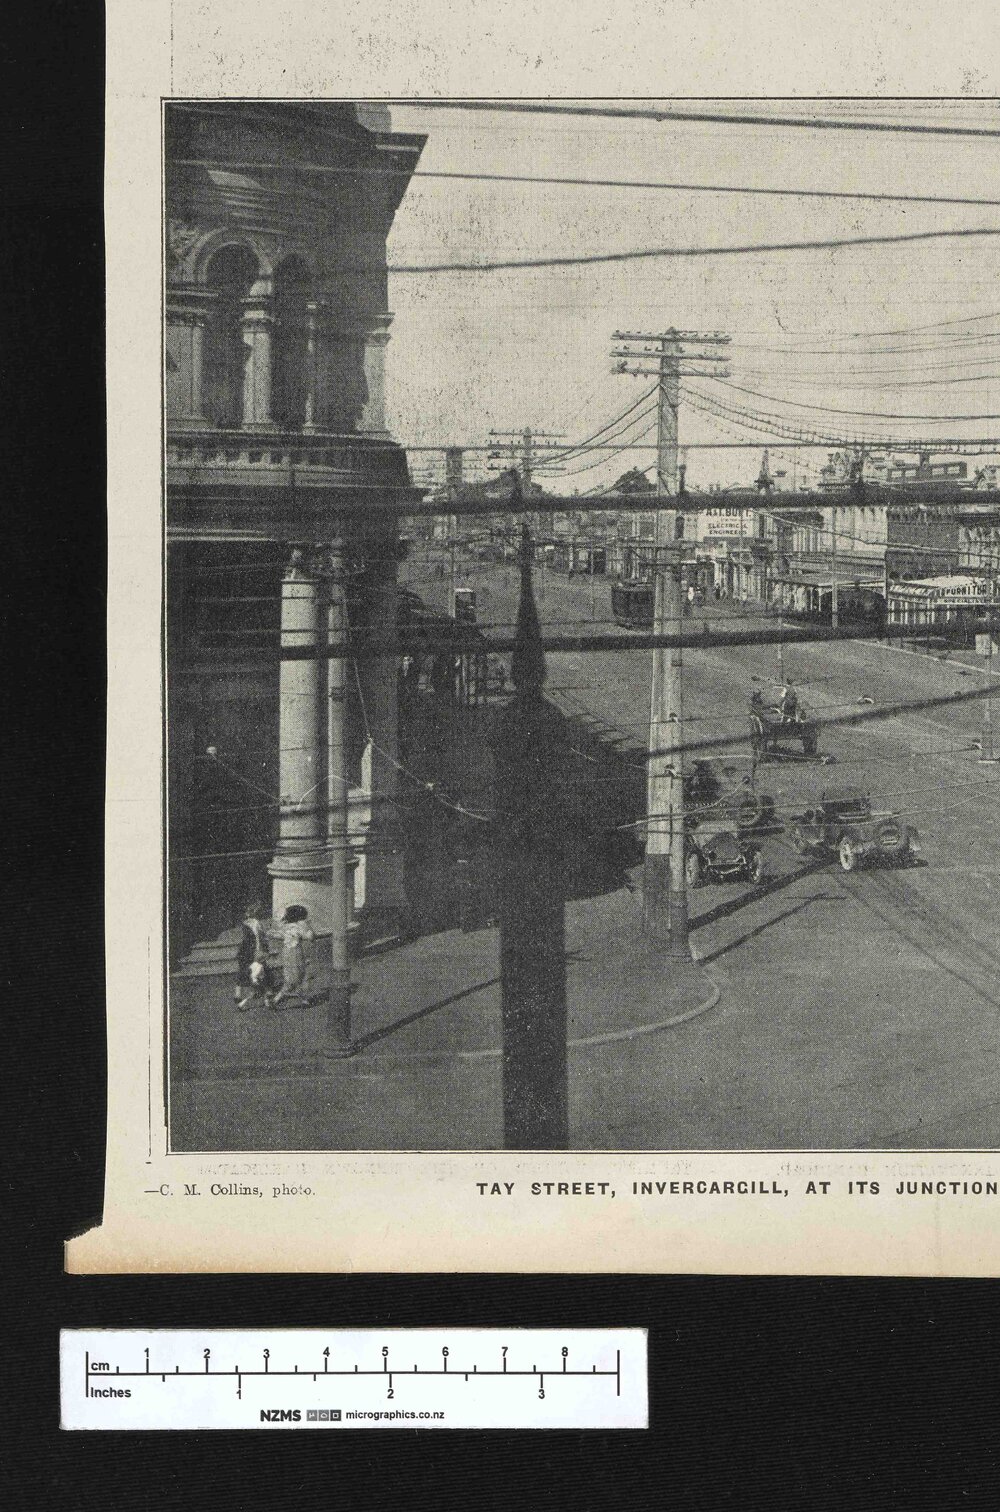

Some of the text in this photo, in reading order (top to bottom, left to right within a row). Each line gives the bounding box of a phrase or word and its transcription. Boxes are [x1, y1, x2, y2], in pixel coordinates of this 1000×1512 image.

[184, 1184, 201, 1196] M.
[210, 1183, 270, 1199] Collins,
[272, 1184, 316, 1199] photo.
[477, 1182, 514, 1195] TAY
[532, 1182, 615, 1198] STREET,
[633, 1181, 789, 1198] INVERCARGILL,
[806, 1182, 831, 1194] AT
[849, 1182, 880, 1194] ITS
[896, 1181, 998, 1195] JUNCTION
[144, 1347, 569, 1359] 1 2 3 4 5 6 7 8
[91, 1361, 110, 1371] cm
[90, 1387, 132, 1399] Inches
[236, 1389, 546, 1399] 1 2 3
[260, 1410, 445, 1422] NZMS micrographics.co.nz
